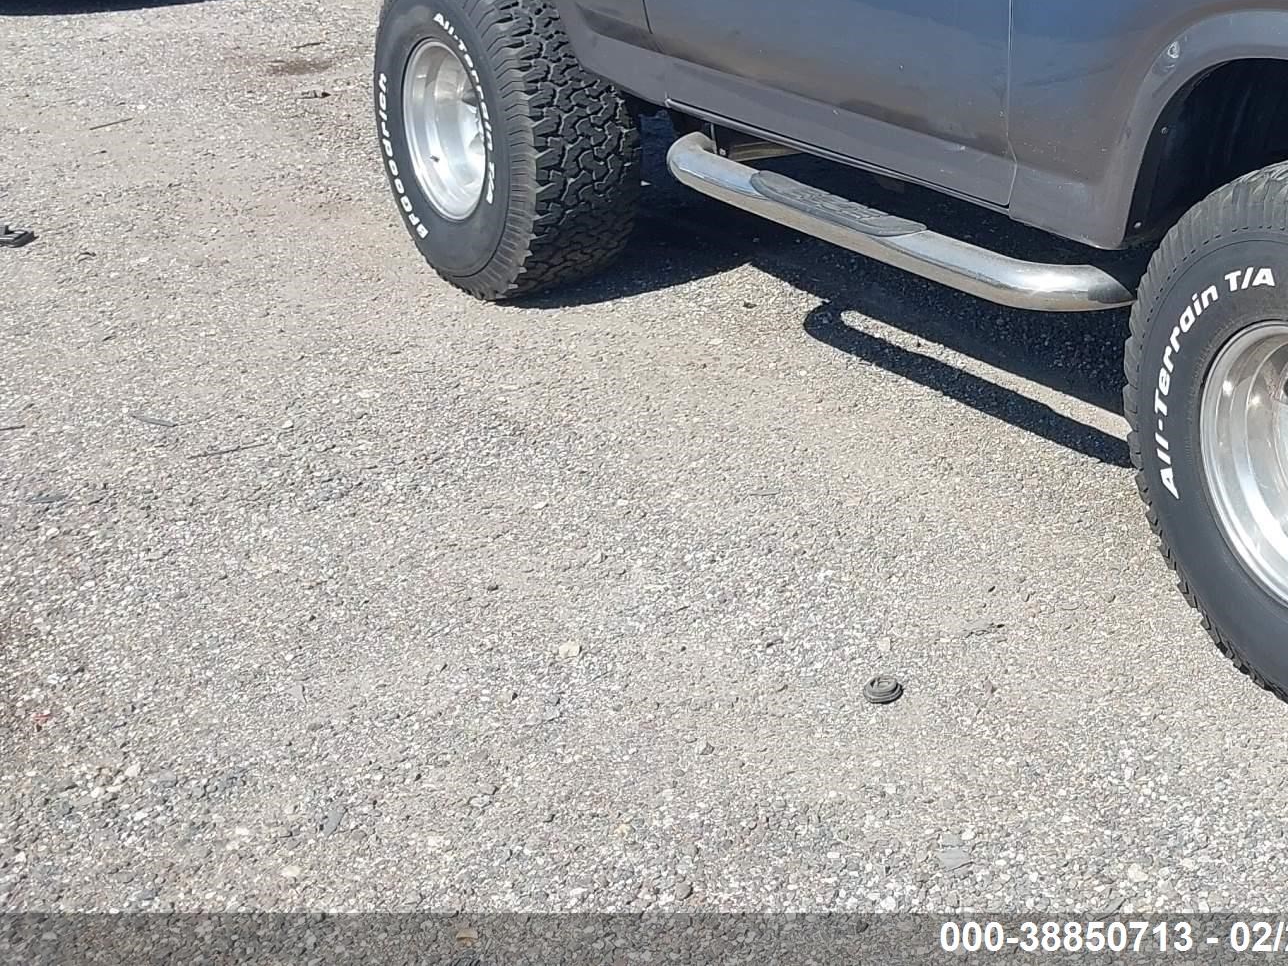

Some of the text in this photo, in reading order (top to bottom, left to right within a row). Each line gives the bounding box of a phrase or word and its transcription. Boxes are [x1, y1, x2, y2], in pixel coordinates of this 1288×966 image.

[379, 73, 429, 239] BFGoodrich
[433, 12, 493, 151] All-Terrain
[1154, 266, 1276, 500] All-Terrain T/A
